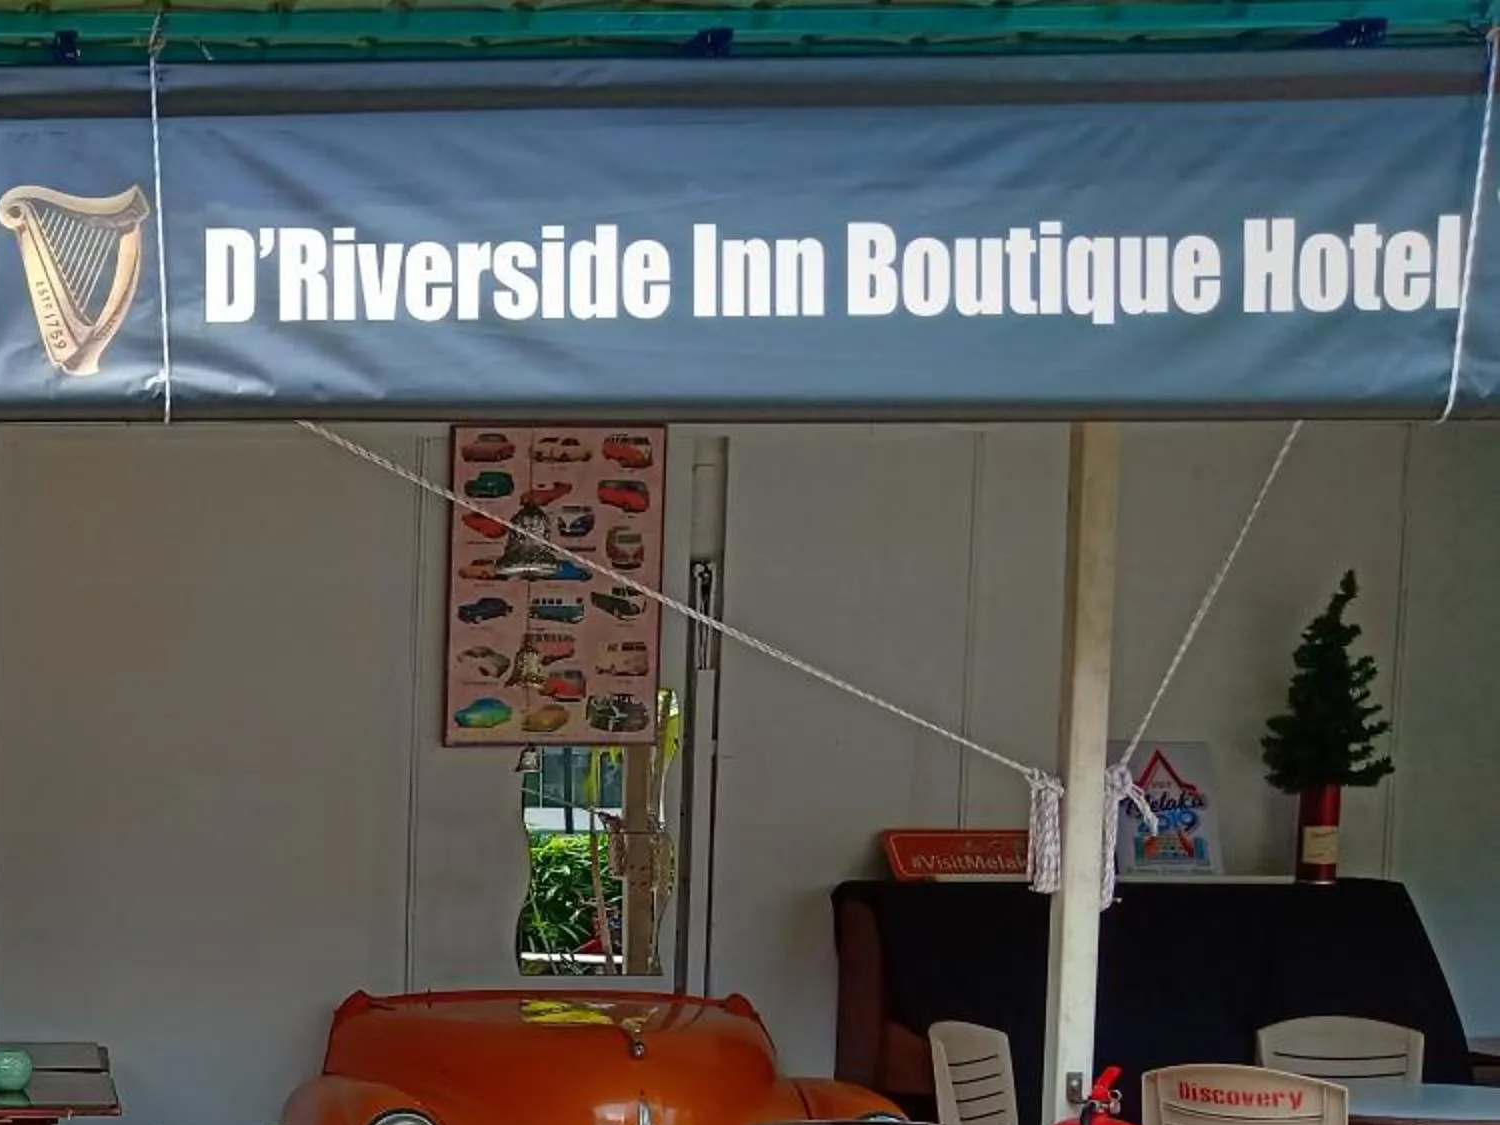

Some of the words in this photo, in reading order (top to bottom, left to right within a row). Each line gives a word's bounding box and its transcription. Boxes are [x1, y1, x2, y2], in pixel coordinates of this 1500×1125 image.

[204, 224, 672, 323] D'Riverside
[692, 222, 826, 318] Inn
[846, 220, 1222, 325] Boutique
[1242, 214, 1462, 314] Hotel
[911, 854, 1028, 871] #VisitMelak
[1176, 1080, 1304, 1111] Discovery
